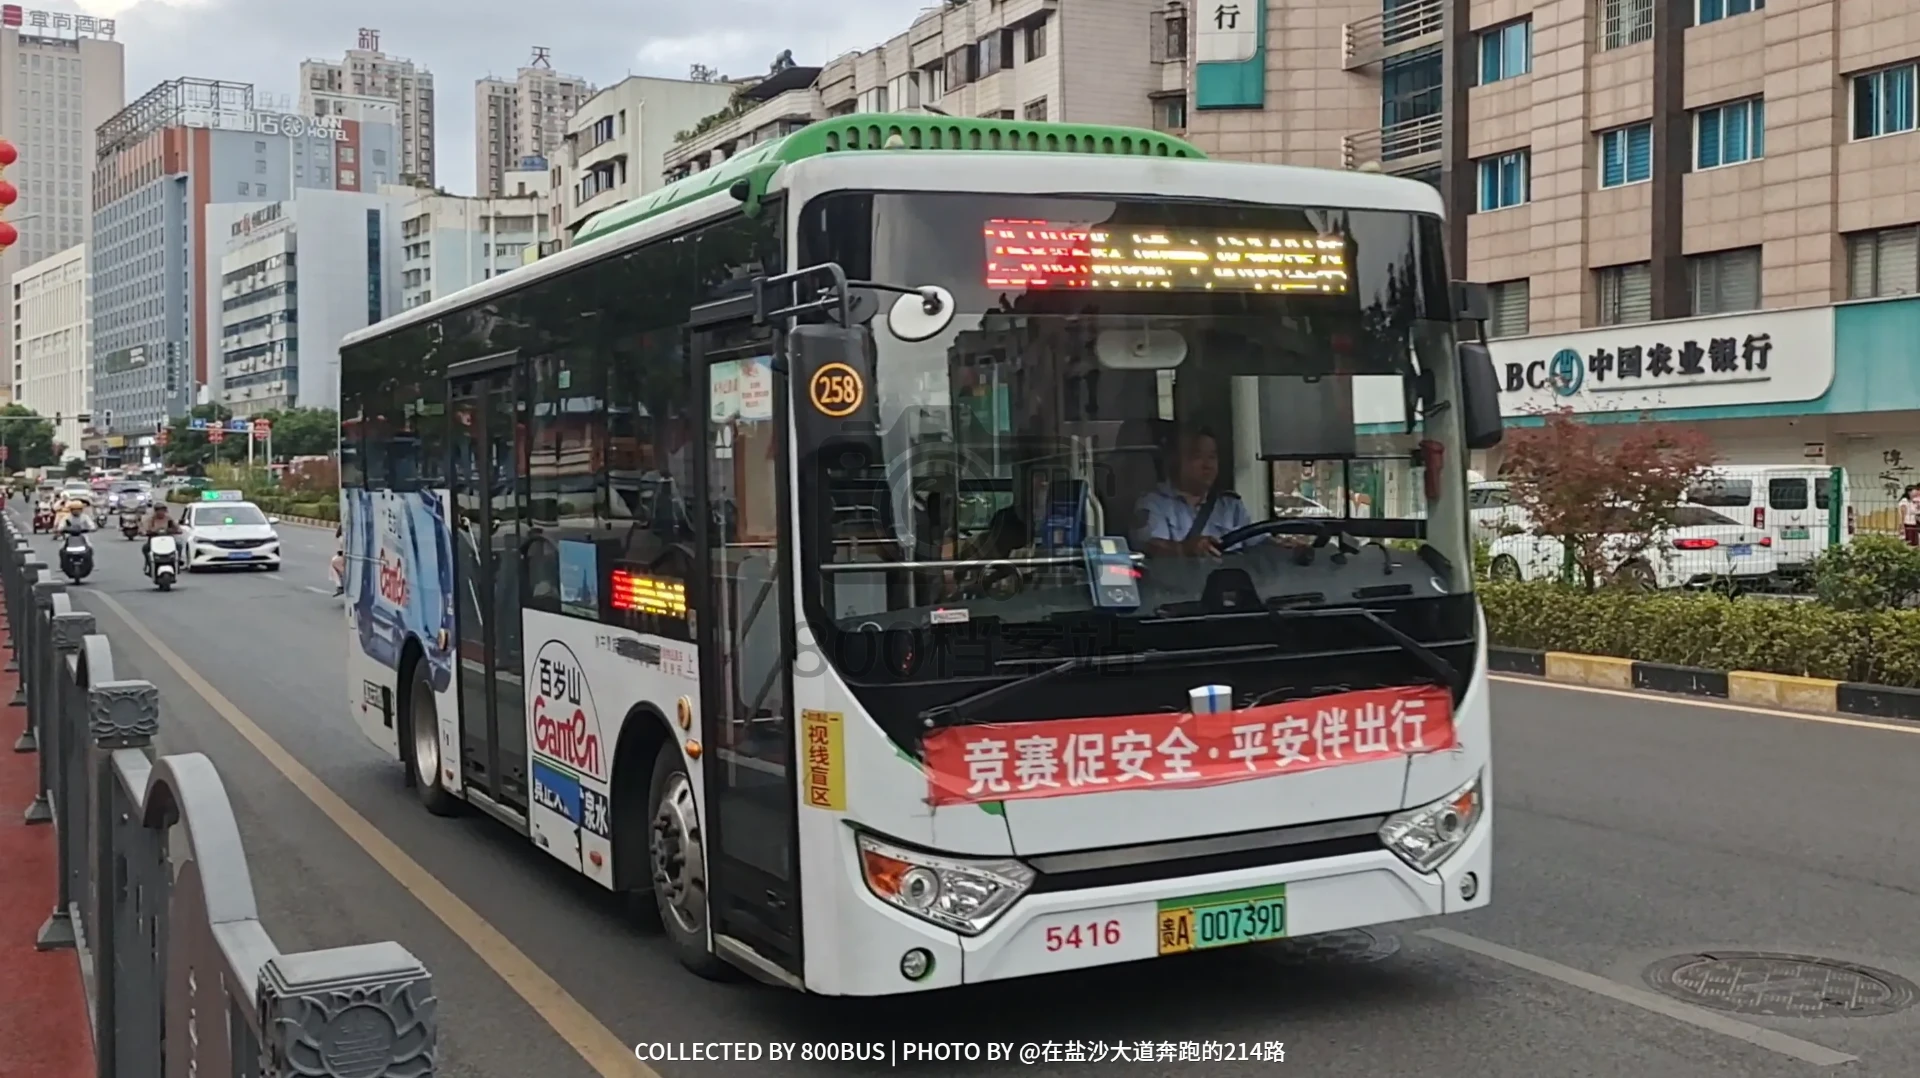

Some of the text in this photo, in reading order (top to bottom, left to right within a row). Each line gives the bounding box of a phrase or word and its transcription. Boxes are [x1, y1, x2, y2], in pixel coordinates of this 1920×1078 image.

[29, 10, 116, 35] 宜尚酒店
[1214, 4, 1240, 30] 行
[358, 28, 380, 52] 新
[307, 126, 350, 142] HOTEL
[1588, 332, 1773, 382] 中国农业银行
[819, 375, 856, 404] 258
[1496, 359, 1546, 393] BC
[539, 657, 581, 706] 百岁山
[533, 695, 599, 774] Ganten
[963, 698, 1428, 796] 竞赛促安全·平安伴出行
[807, 724, 832, 807] 视线盲区
[1045, 919, 1121, 952] 5416
